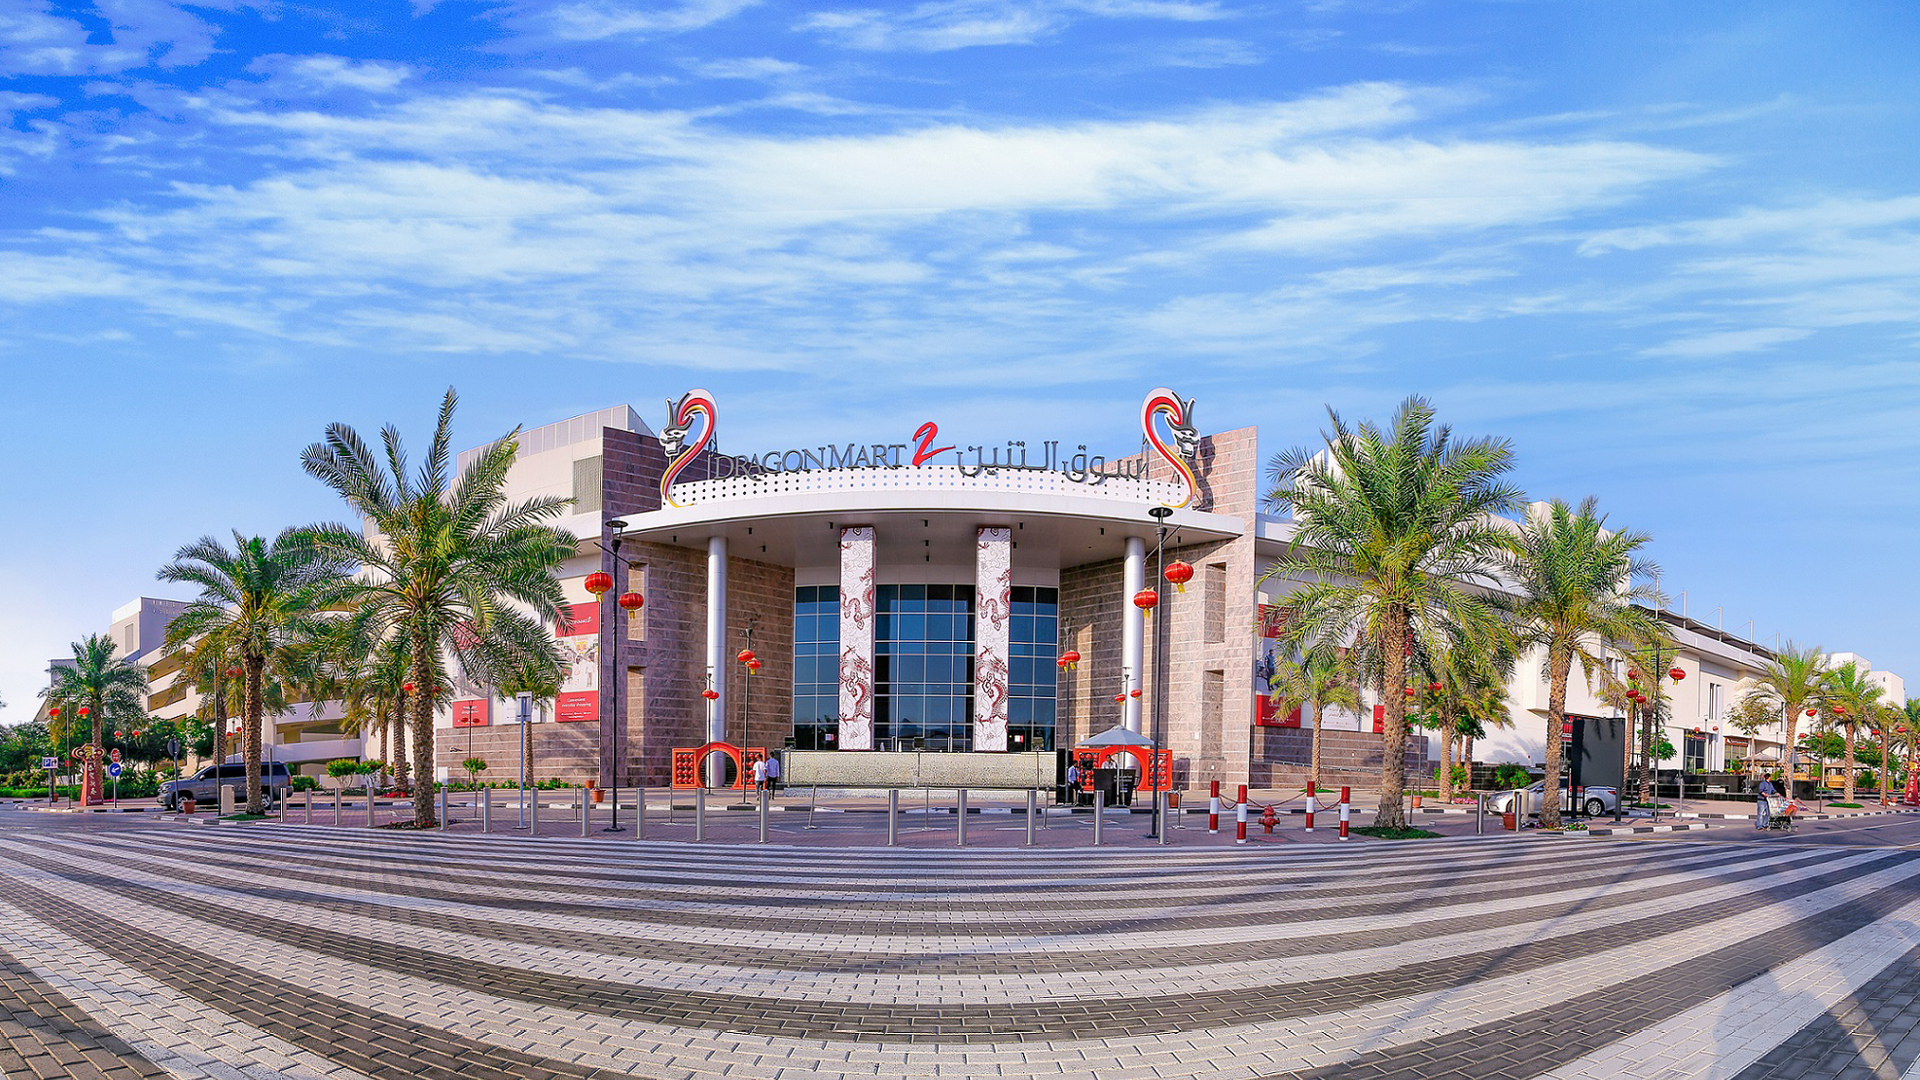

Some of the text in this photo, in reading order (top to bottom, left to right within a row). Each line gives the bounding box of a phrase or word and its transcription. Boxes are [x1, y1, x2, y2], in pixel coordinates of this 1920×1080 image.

[912, 421, 956, 467] 2
[956, 440, 1143, 486] سوق التنين
